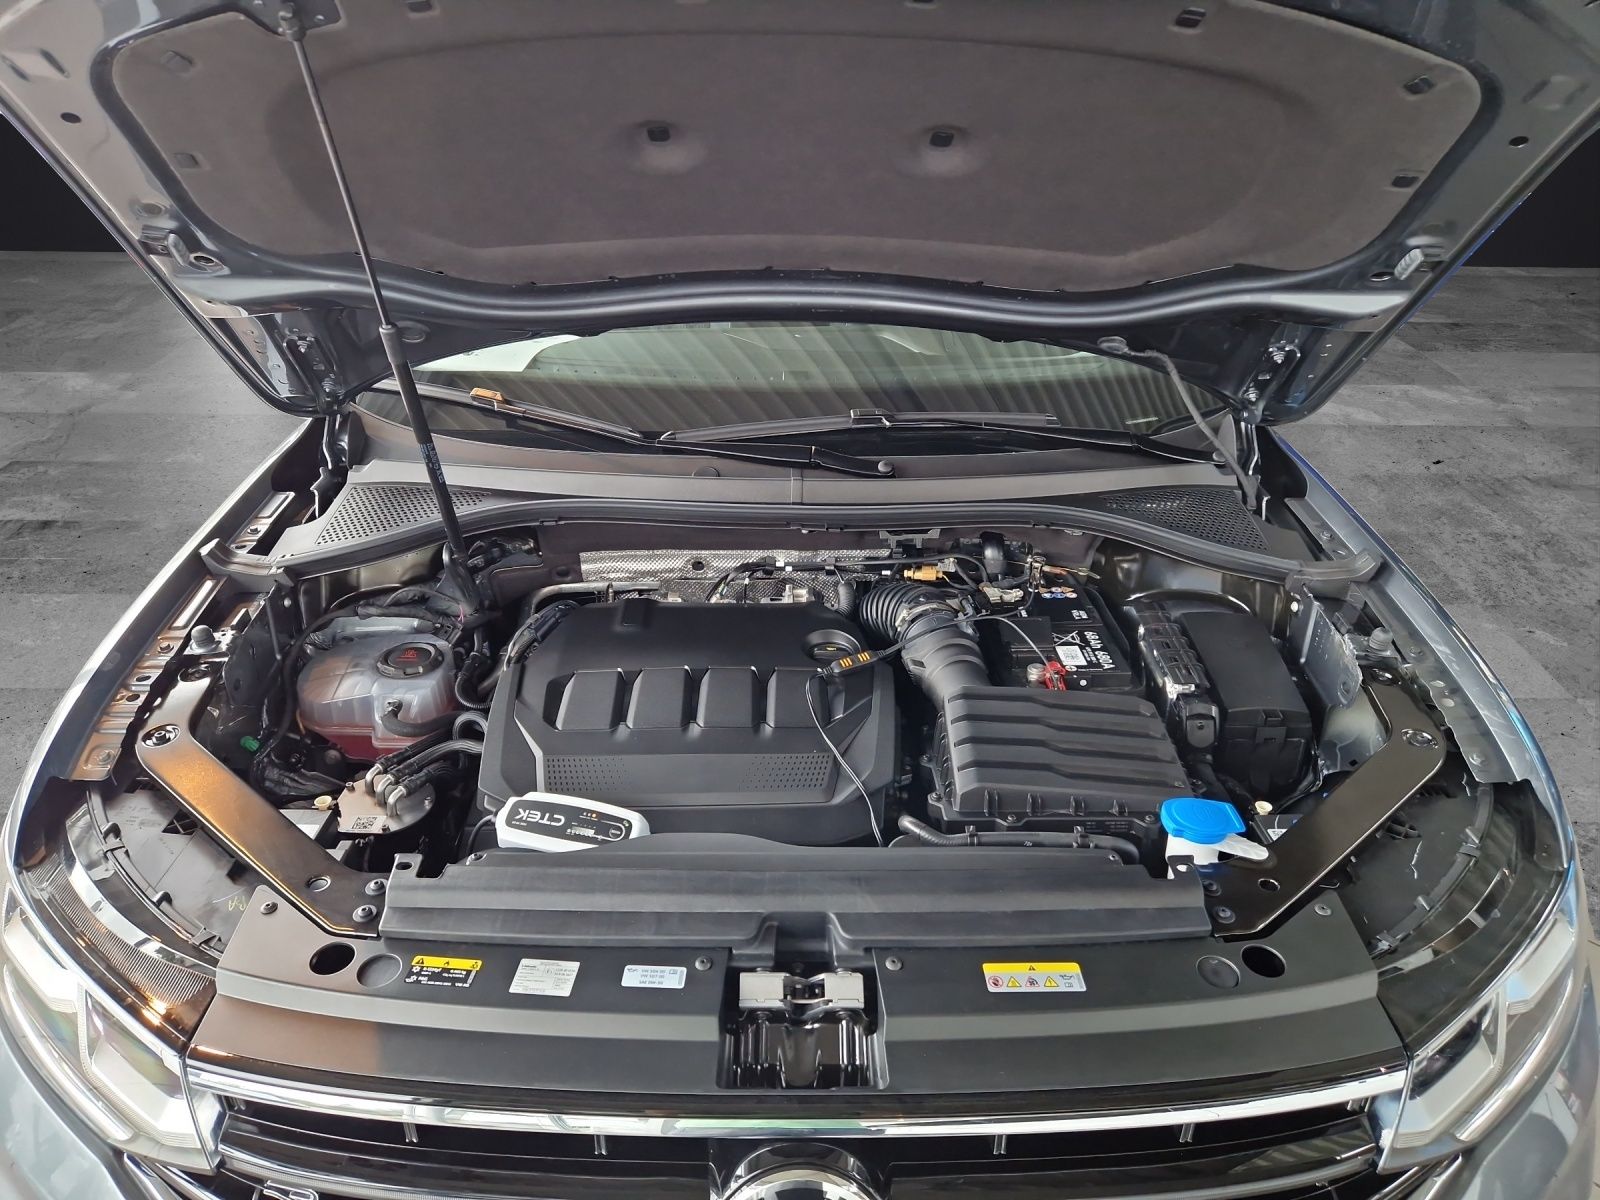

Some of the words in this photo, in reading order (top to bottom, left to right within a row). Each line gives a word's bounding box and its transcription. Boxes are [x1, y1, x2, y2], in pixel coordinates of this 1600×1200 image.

[1084, 631, 1104, 649] 68Ah
[1095, 650, 1116, 669] 680A
[515, 808, 565, 826] CTEK
